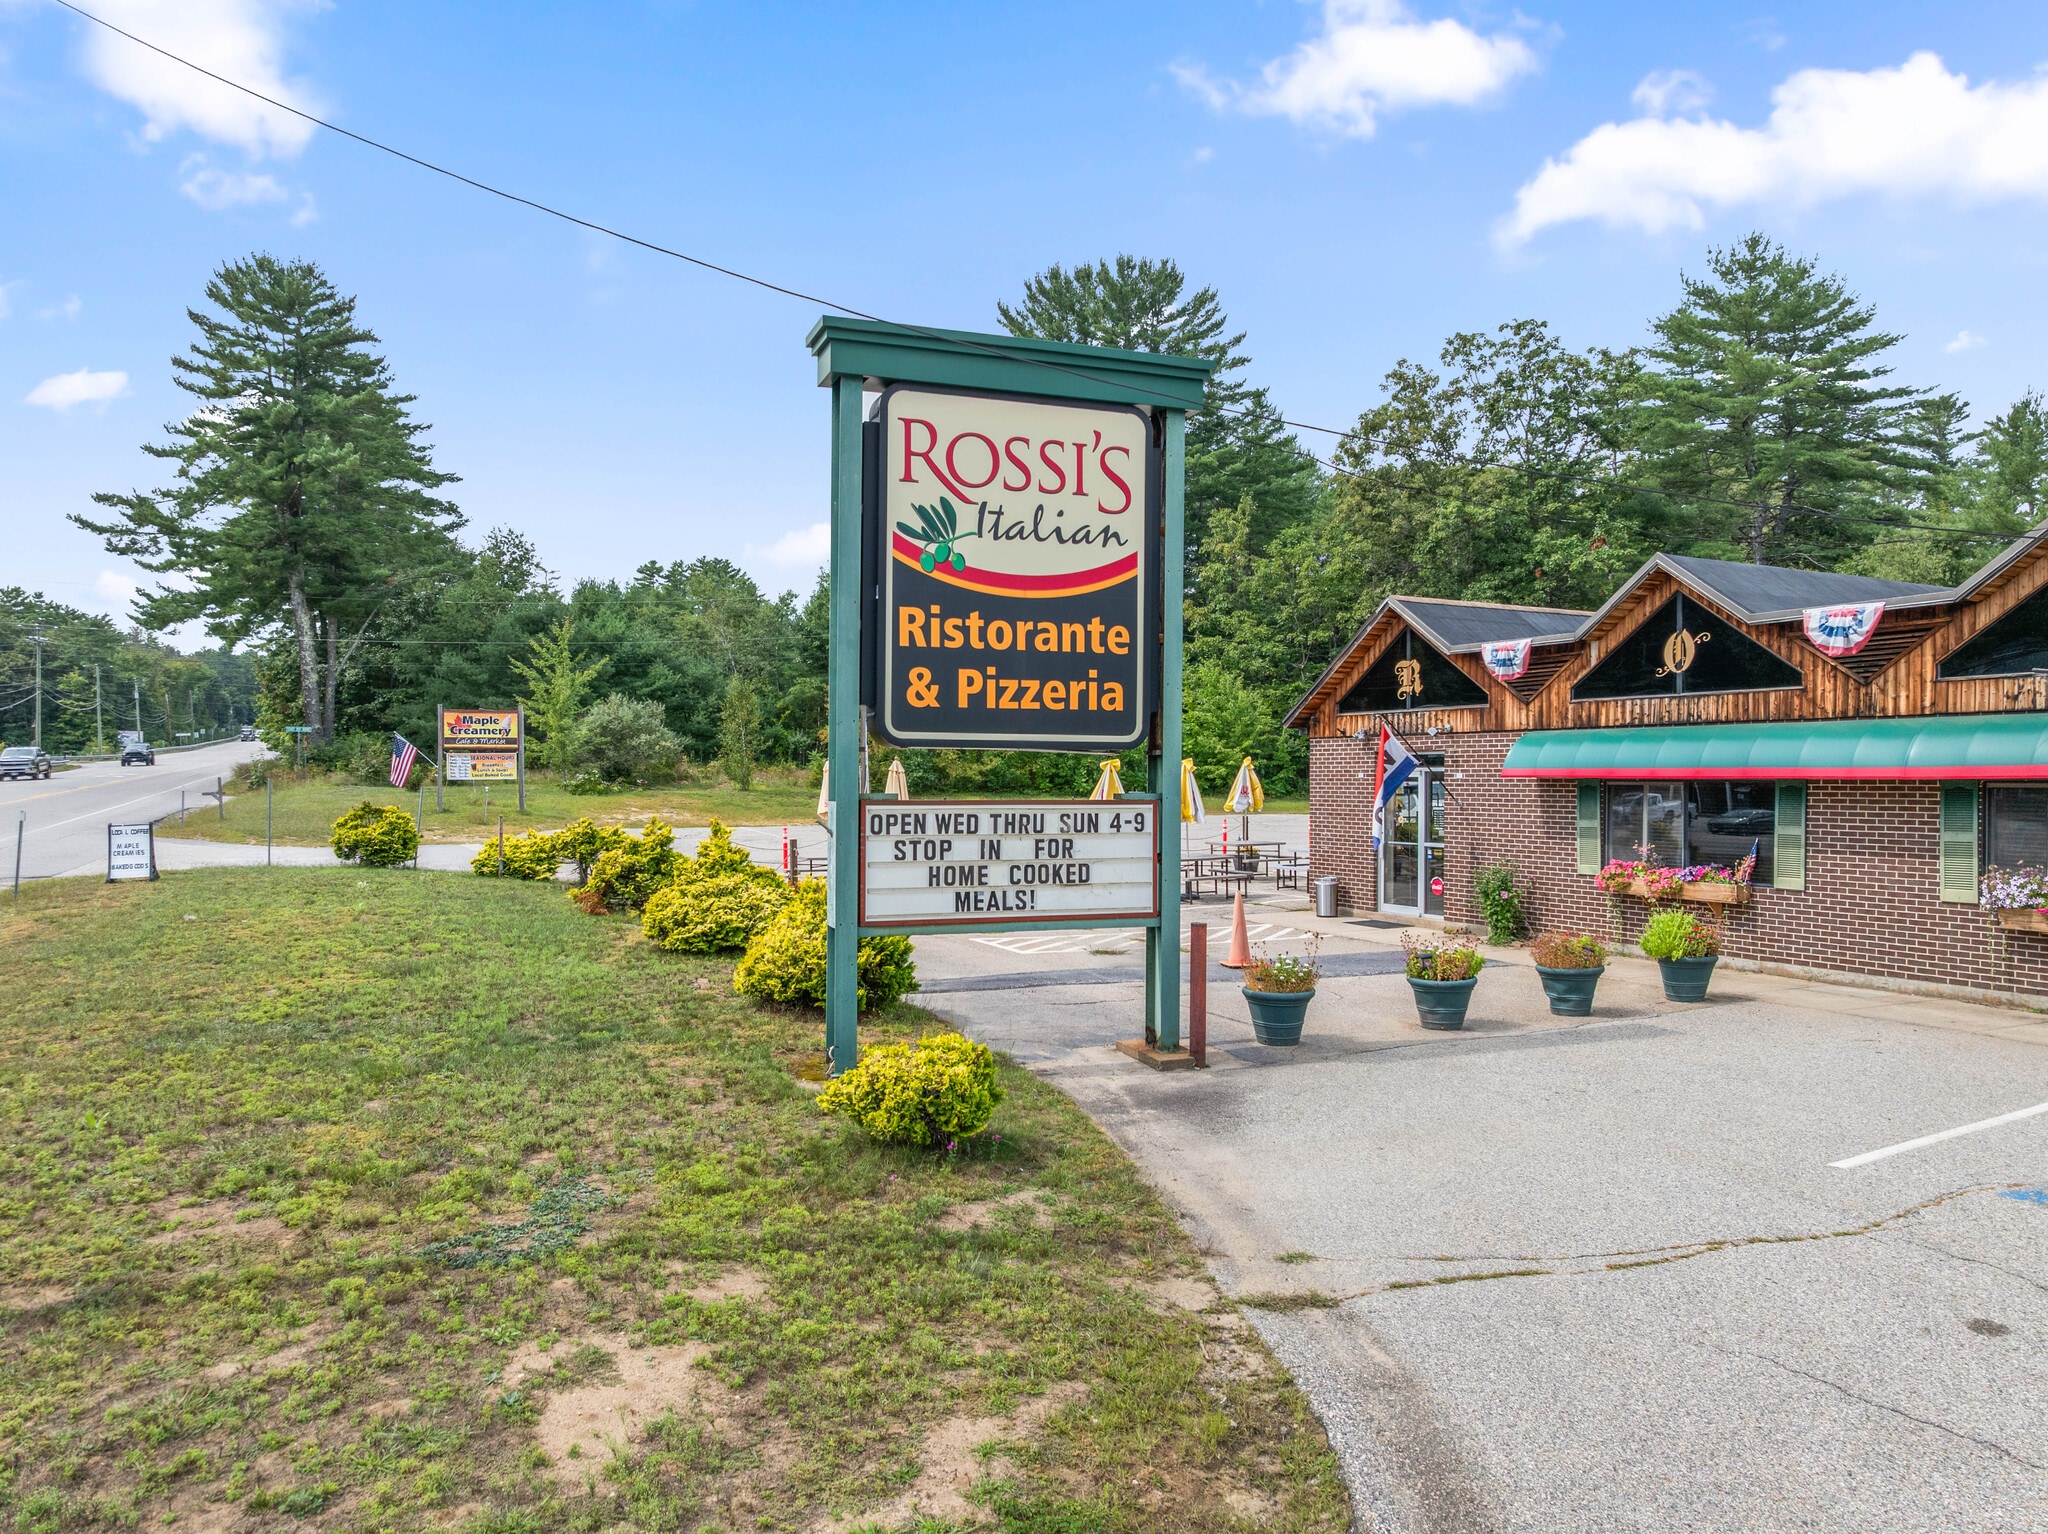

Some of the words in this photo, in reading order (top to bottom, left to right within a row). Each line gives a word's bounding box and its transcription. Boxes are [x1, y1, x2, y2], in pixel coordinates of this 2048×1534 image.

[898, 417, 1132, 514] ROSSI'S
[977, 501, 1128, 548] Italian
[899, 605, 1130, 655] Ristorante
[906, 666, 940, 708] &
[958, 666, 1124, 711] Pizzeria
[450, 726, 511, 737] Creamery
[463, 716, 500, 726] Maple
[870, 813, 926, 835] OPEN
[935, 813, 979, 834] WED
[990, 813, 1044, 834] THRU
[1060, 813, 1099, 833] SUN
[1109, 812, 1145, 833] 4-9
[894, 839, 952, 861] STOP
[980, 839, 1001, 860] IN
[1034, 838, 1074, 859] FOR
[928, 865, 988, 887] HOME
[1009, 863, 1090, 885] COOKED
[955, 889, 1035, 912] MEALS!
